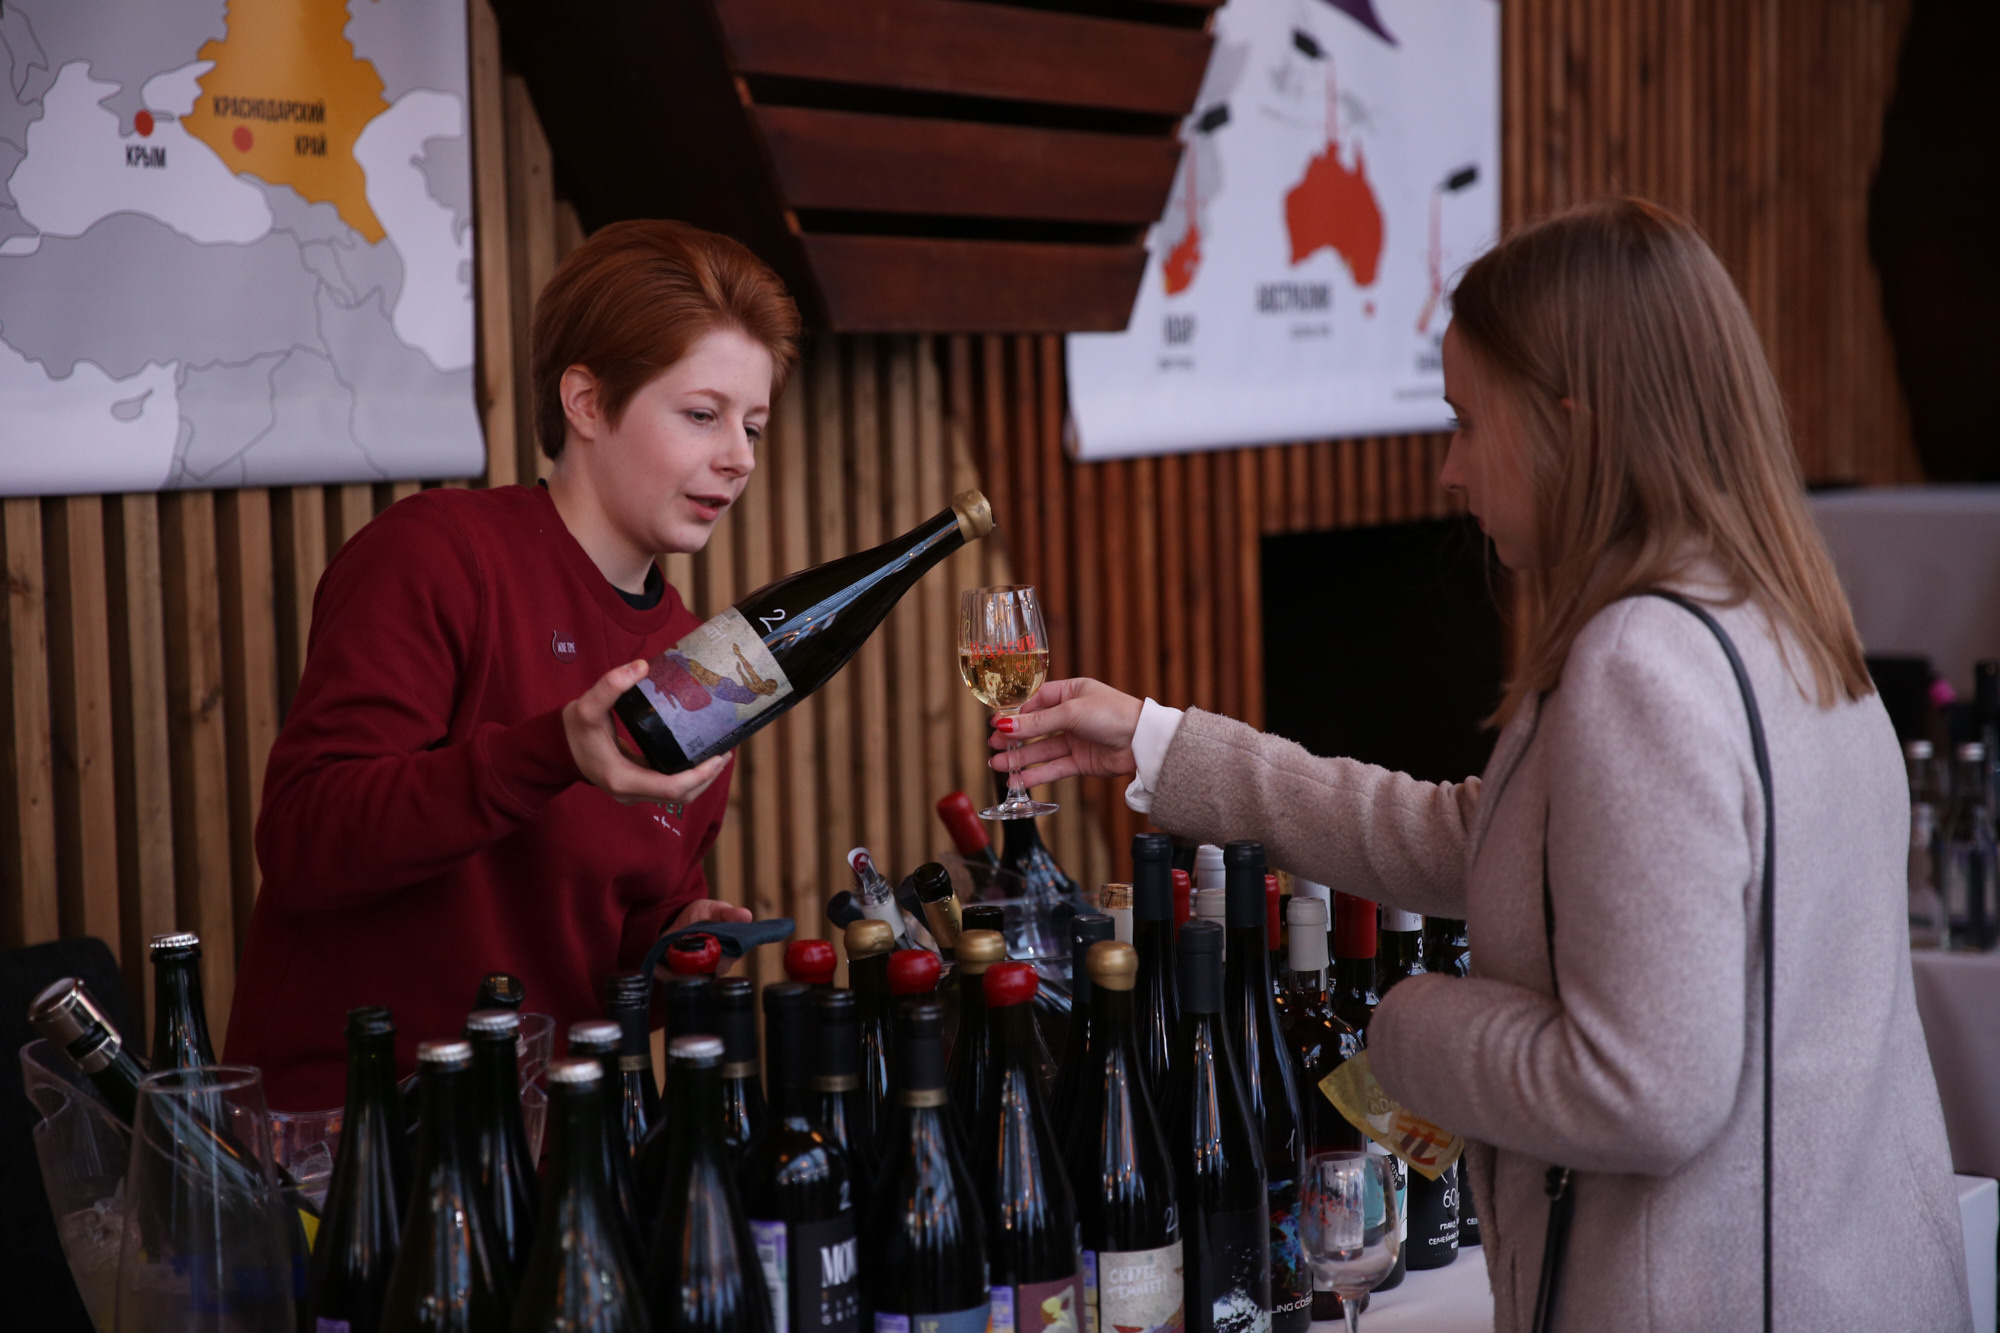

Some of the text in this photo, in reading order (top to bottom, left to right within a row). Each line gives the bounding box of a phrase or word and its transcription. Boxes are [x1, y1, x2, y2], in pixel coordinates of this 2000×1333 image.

[214, 97, 326, 123] КРАСНОДАРСКИЙ
[295, 132, 327, 156] КРАЙ
[126, 145, 166, 168] КРЫМ
[758, 608, 786, 633] 2
